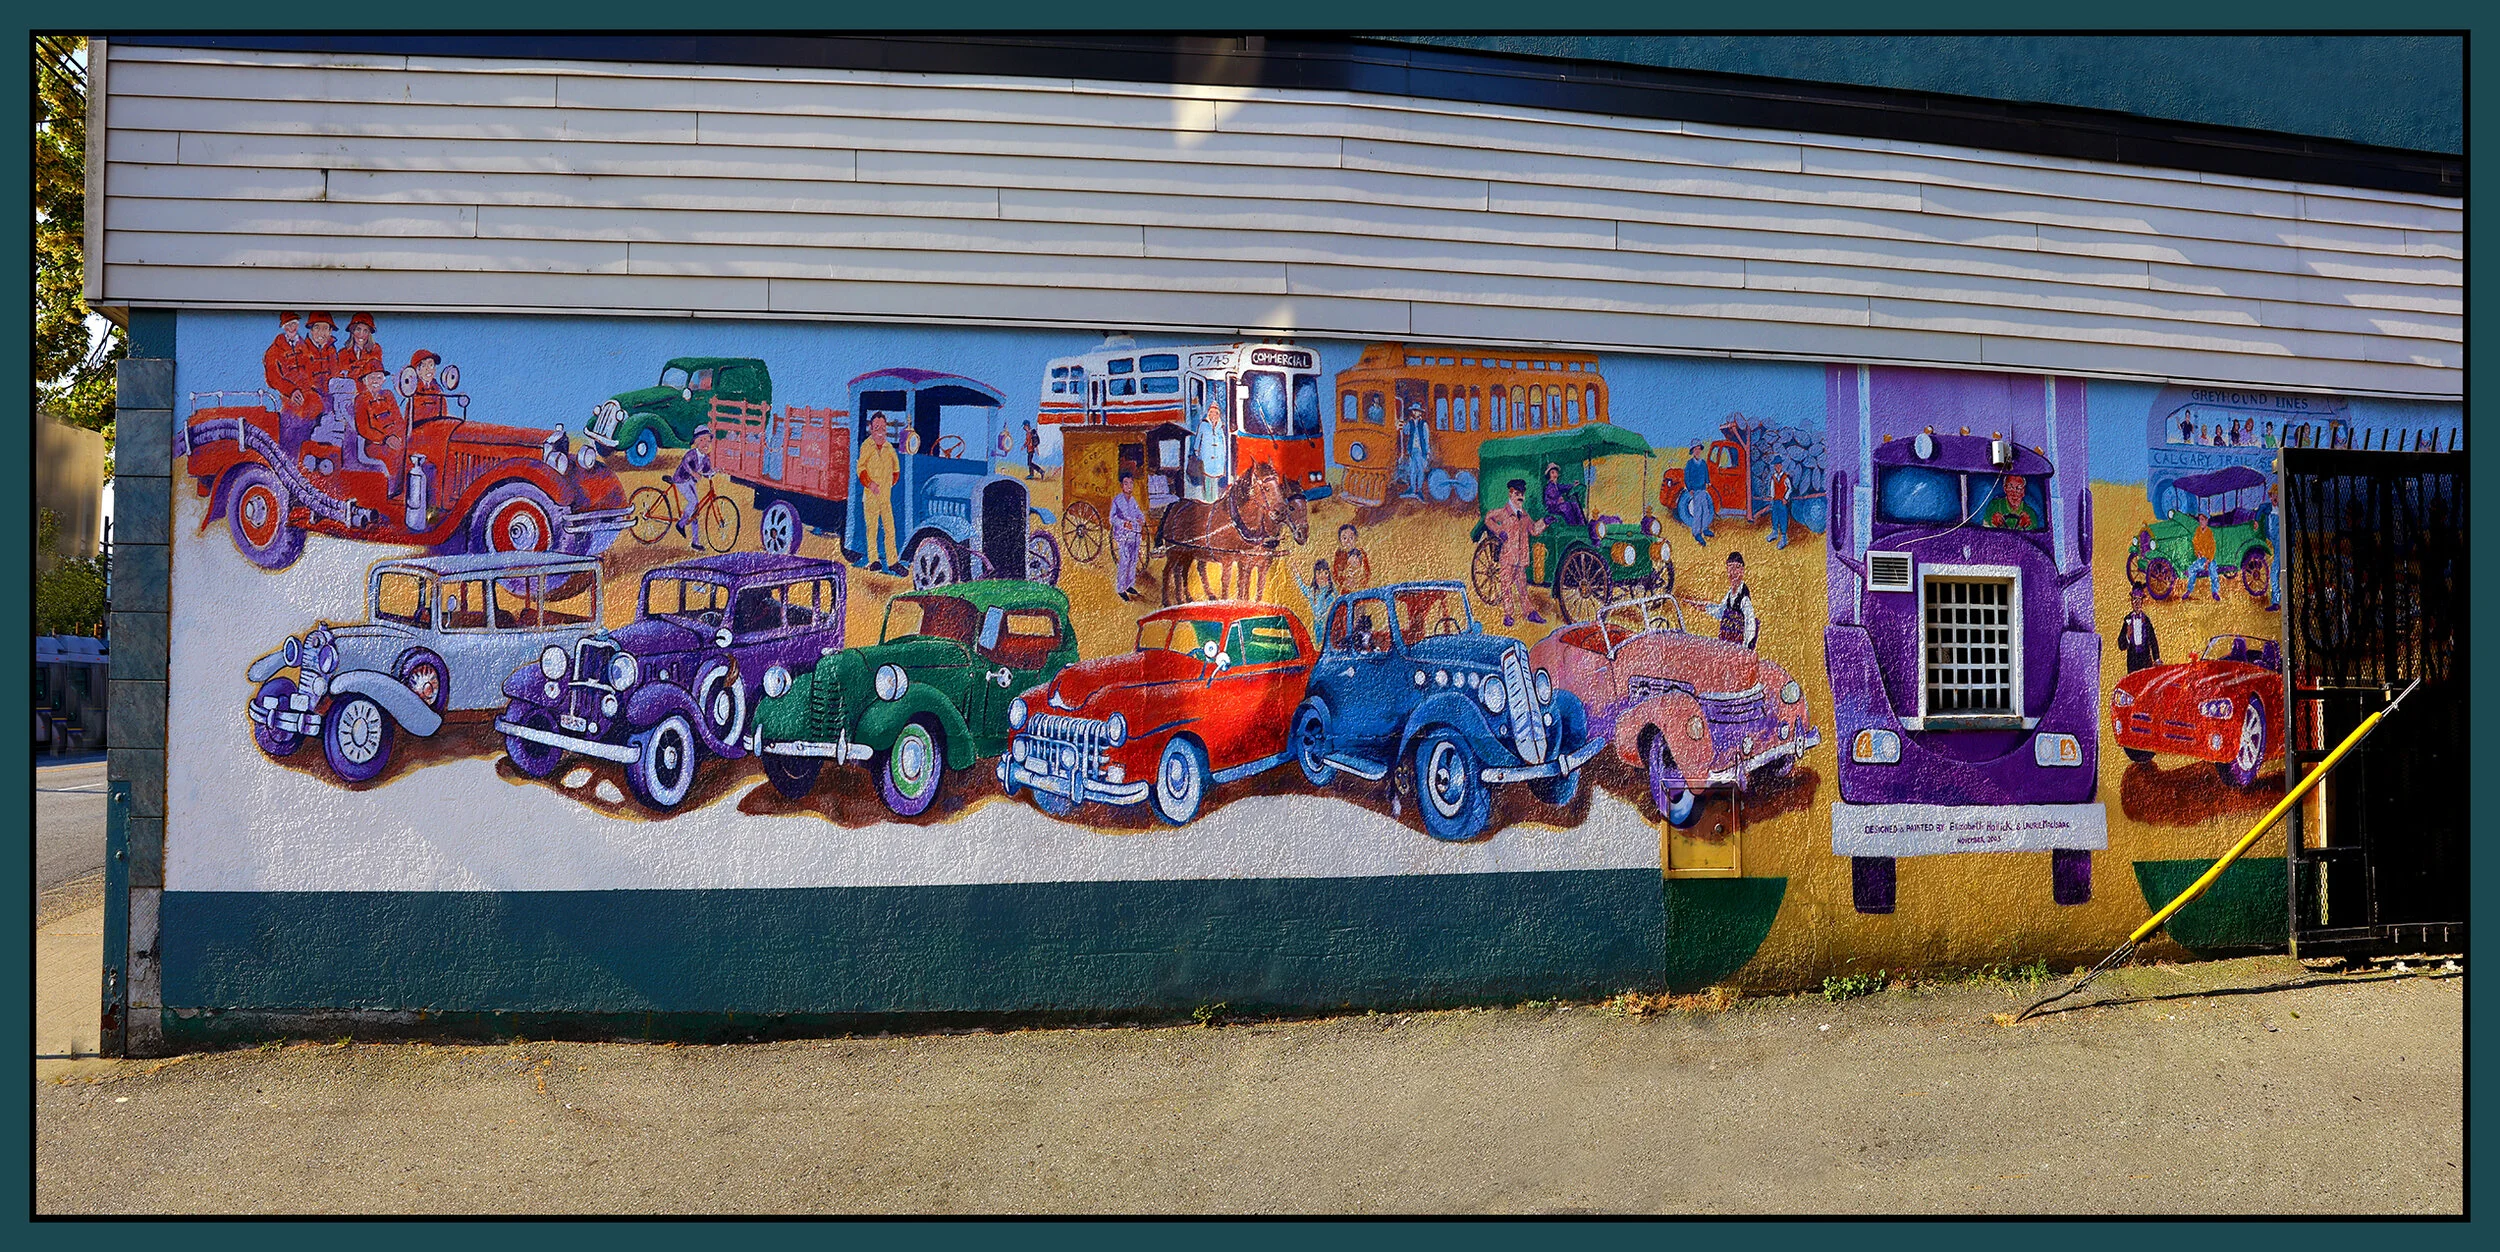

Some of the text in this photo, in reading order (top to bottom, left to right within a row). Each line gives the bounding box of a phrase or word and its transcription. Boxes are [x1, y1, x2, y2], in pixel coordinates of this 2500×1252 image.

[1196, 355, 1230, 367] 2745
[1252, 352, 1310, 367] COMMERCIAL
[2191, 389, 2309, 409] GREYHOUND LINES
[2153, 452, 2211, 467] CALGARY
[2218, 454, 2251, 466] TRAIL
[1864, 825, 1898, 834] DESIGNED
[1906, 823, 1935, 832] PAINTED
